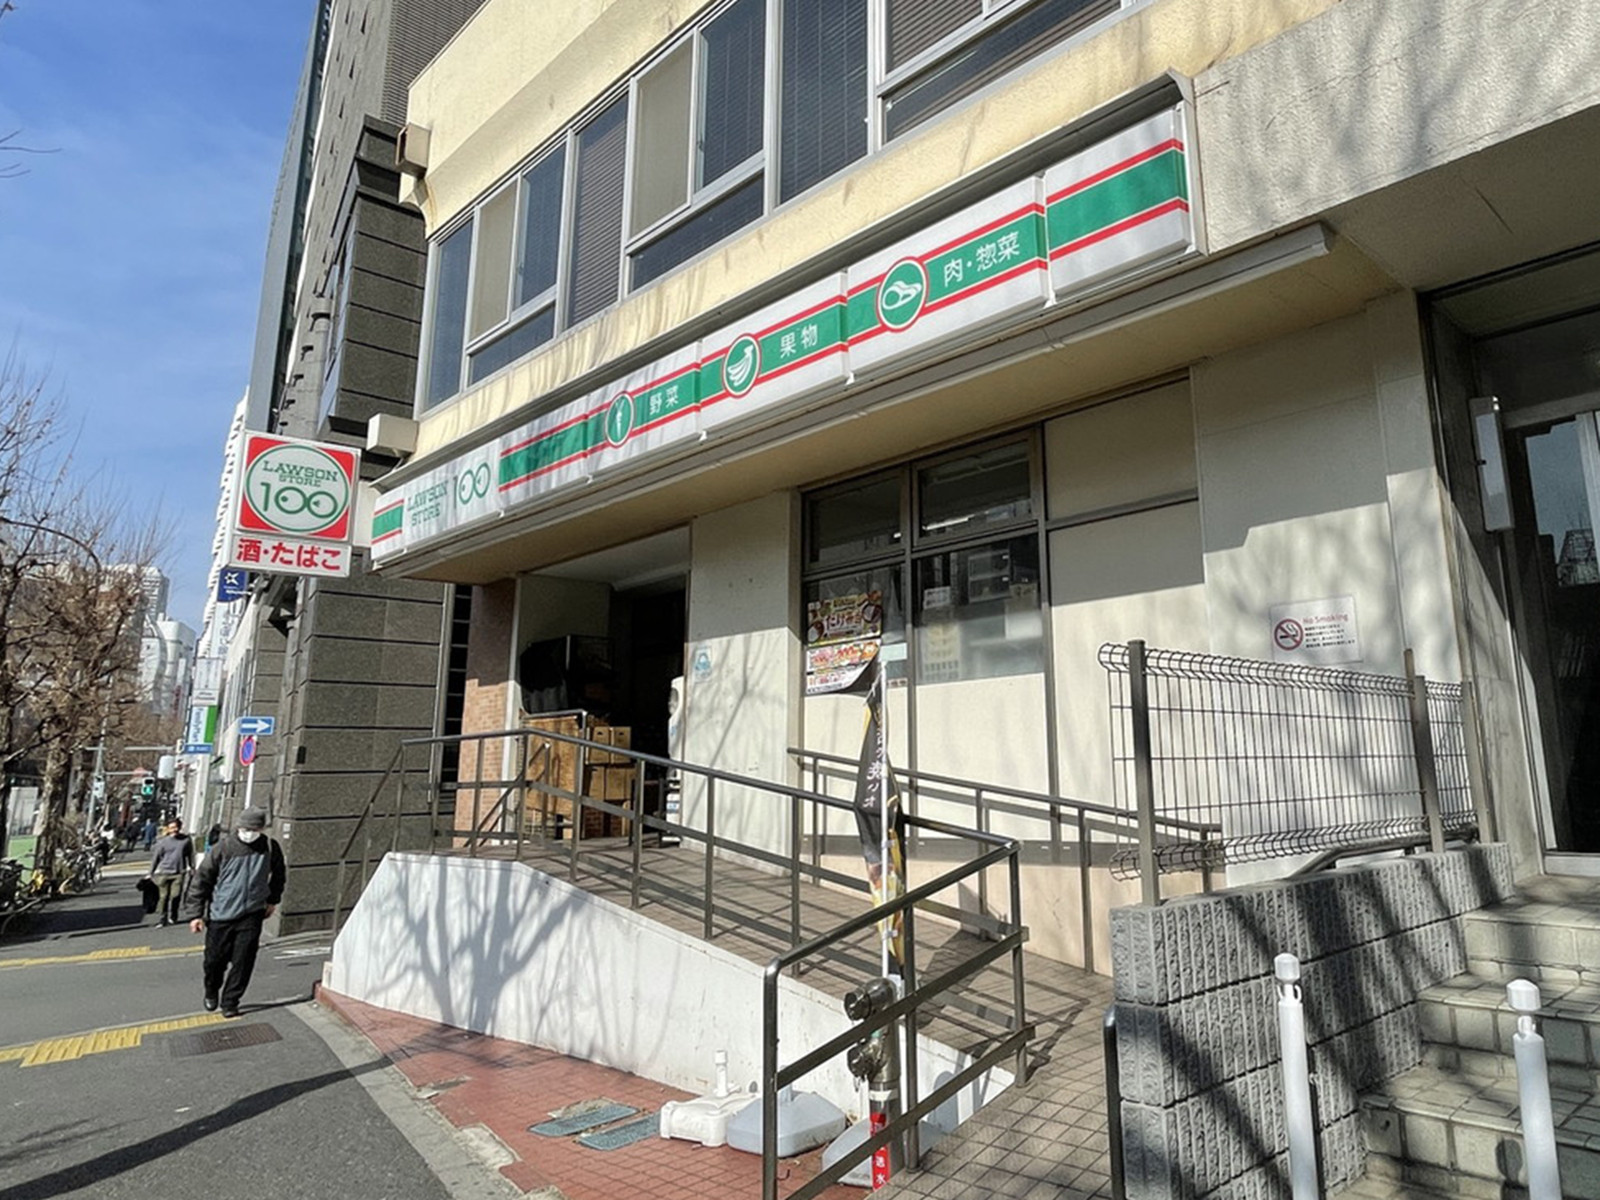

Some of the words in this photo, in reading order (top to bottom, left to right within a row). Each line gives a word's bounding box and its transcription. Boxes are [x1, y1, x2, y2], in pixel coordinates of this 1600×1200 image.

[944, 231, 1020, 287] 肉・惣菜
[780, 324, 818, 359] 果物
[649, 385, 679, 416] 野菜
[263, 460, 338, 482] LAWSON
[279, 474, 321, 488] STORE
[453, 462, 491, 510] 100
[261, 482, 338, 519] 100
[407, 480, 448, 511] LAWSON
[411, 503, 441, 527] STORE
[236, 538, 341, 570] 酒・たばこ
[1315, 614, 1347, 624] Smoking
